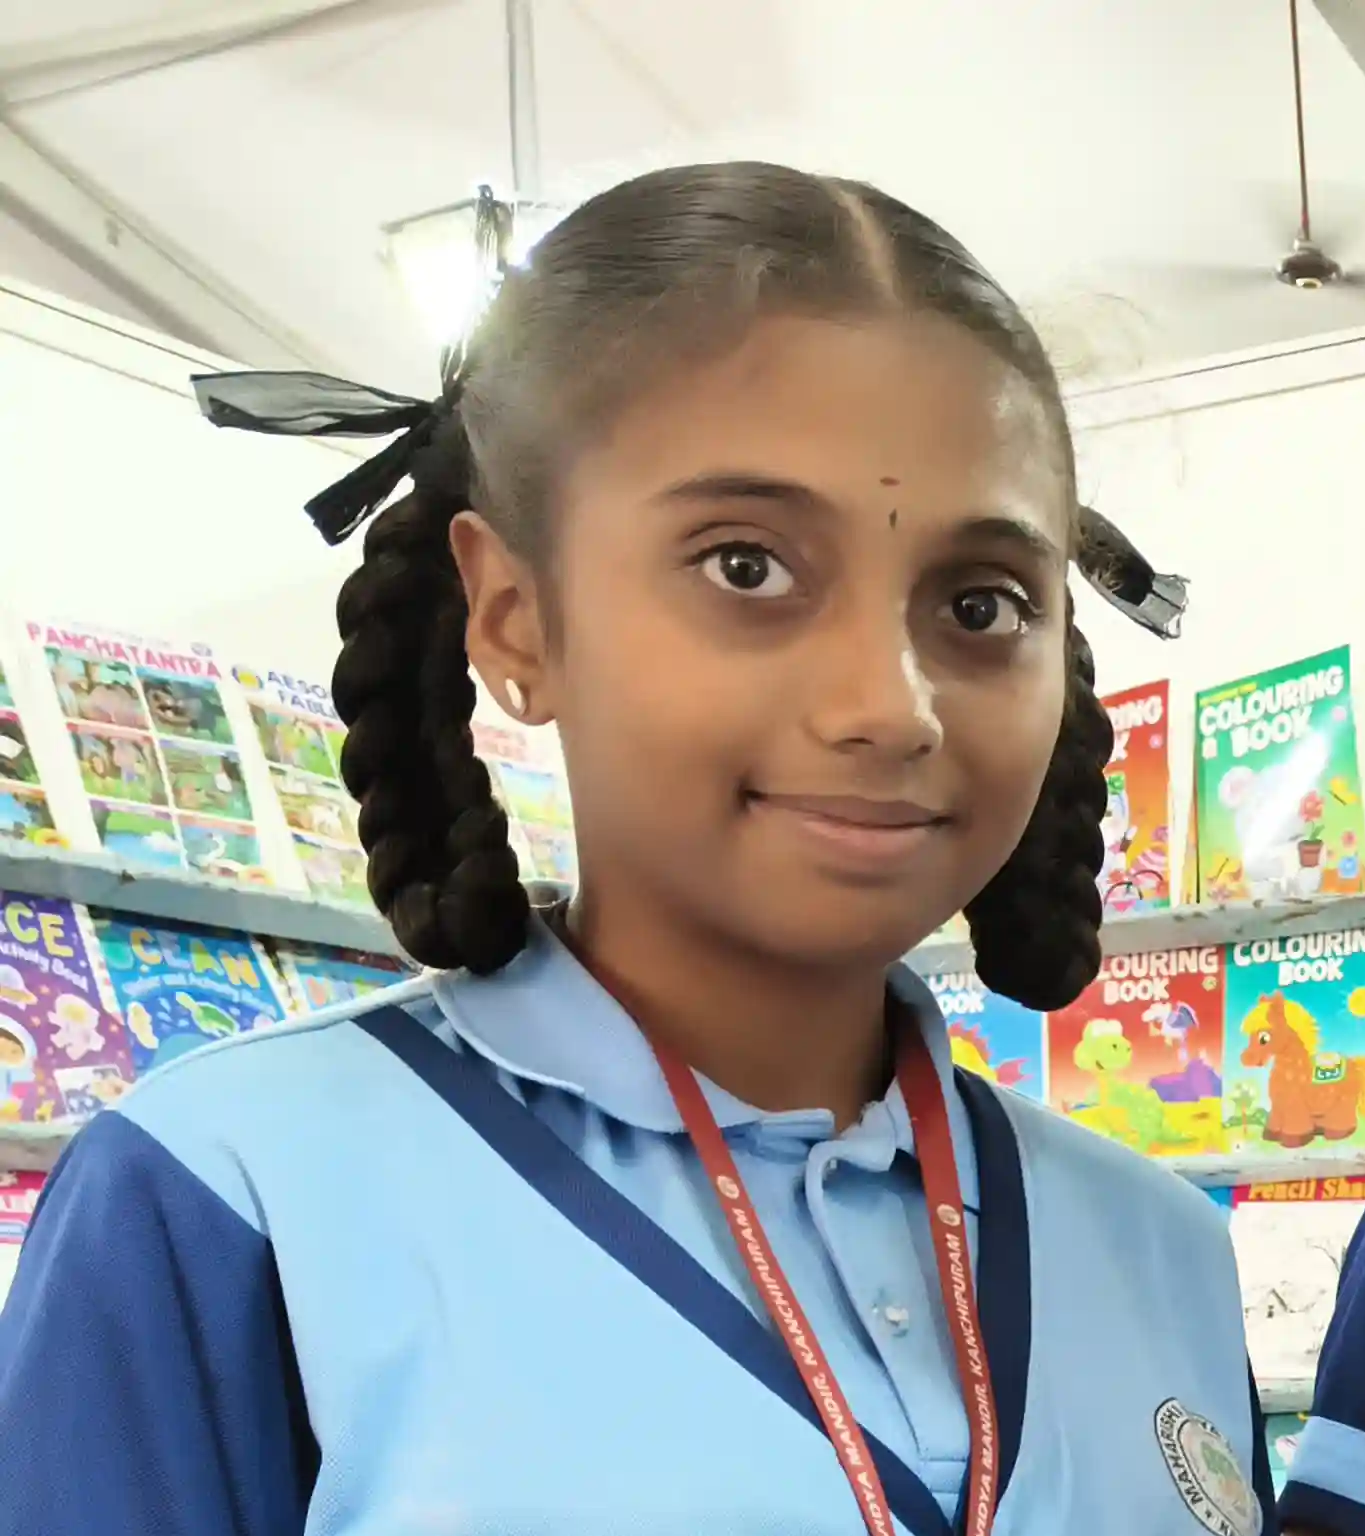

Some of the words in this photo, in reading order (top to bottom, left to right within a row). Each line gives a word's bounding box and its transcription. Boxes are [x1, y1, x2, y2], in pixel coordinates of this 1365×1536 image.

[27, 621, 222, 679] PANCHATANTRA
[1199, 665, 1344, 736] COLOURING
[1230, 706, 1313, 757] BOOK
[1103, 977, 1170, 1006] BOOK
[1278, 955, 1344, 987] BOOK
[732, 1207, 818, 1367] KANCHIPURAM
[947, 1233, 984, 1376] KANCHIPURAM
[1159, 1402, 1204, 1504] MAHARISHI
